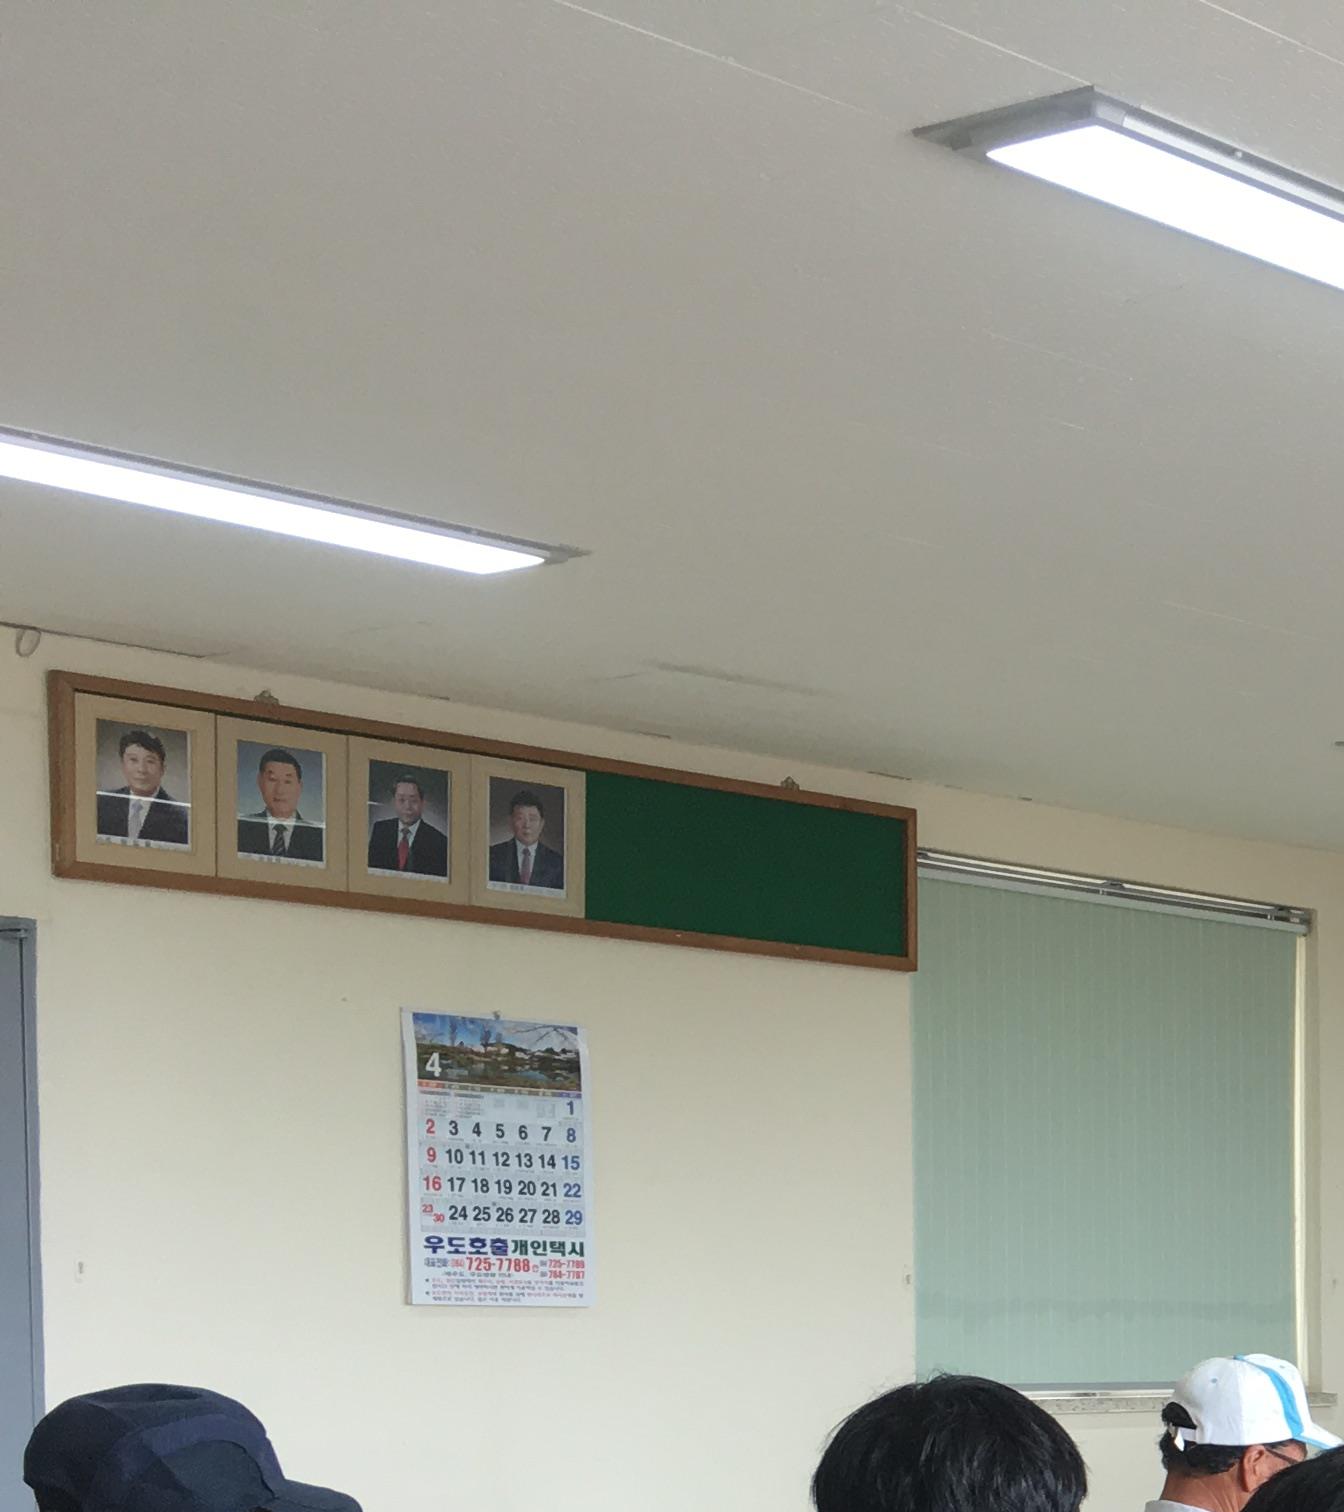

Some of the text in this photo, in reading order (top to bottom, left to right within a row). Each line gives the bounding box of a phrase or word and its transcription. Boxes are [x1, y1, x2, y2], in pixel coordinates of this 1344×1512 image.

[425, 1052, 442, 1077] 4
[566, 1100, 574, 1115] 1
[426, 1118, 576, 1143] 2 3 4 5 6 7 8
[426, 1146, 580, 1170] 9 10 11 12 13 14 15
[423, 1175, 582, 1198] 16 17 18 19 20 21 22
[449, 1205, 468, 1221] 24
[472, 1206, 491, 1222] 25
[496, 1206, 514, 1223] 26
[519, 1208, 537, 1223] 27
[542, 1208, 560, 1225] 28
[565, 1209, 583, 1225] 29
[466, 1257, 530, 1273] 725-7788
